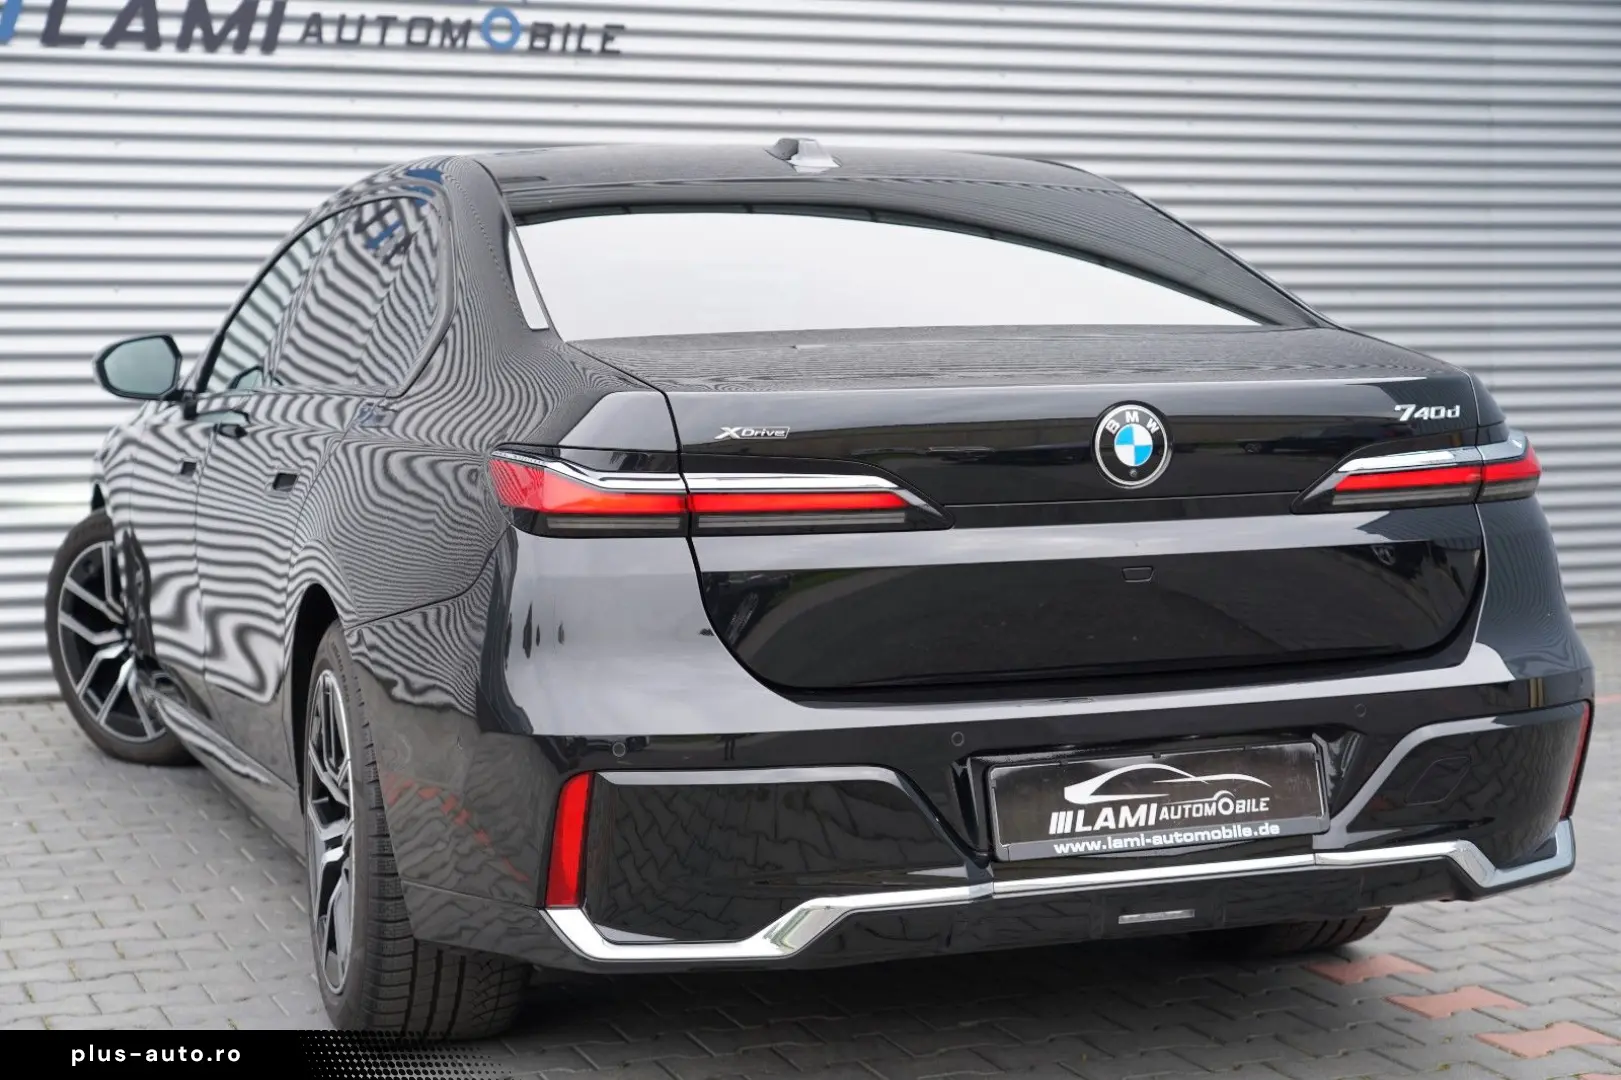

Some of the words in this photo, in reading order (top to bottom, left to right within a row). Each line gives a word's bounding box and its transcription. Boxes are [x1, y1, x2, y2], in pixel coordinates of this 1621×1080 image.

[40, 0, 287, 54] LAMI
[299, 6, 625, 54] AUTOMOBILE
[1105, 410, 1160, 435] BMW
[1394, 403, 1460, 421] 740d
[1074, 803, 1158, 833] LAMI
[1158, 796, 1271, 821] AUTOMOBILE
[1053, 822, 1281, 854] www.lami-automobile.de
